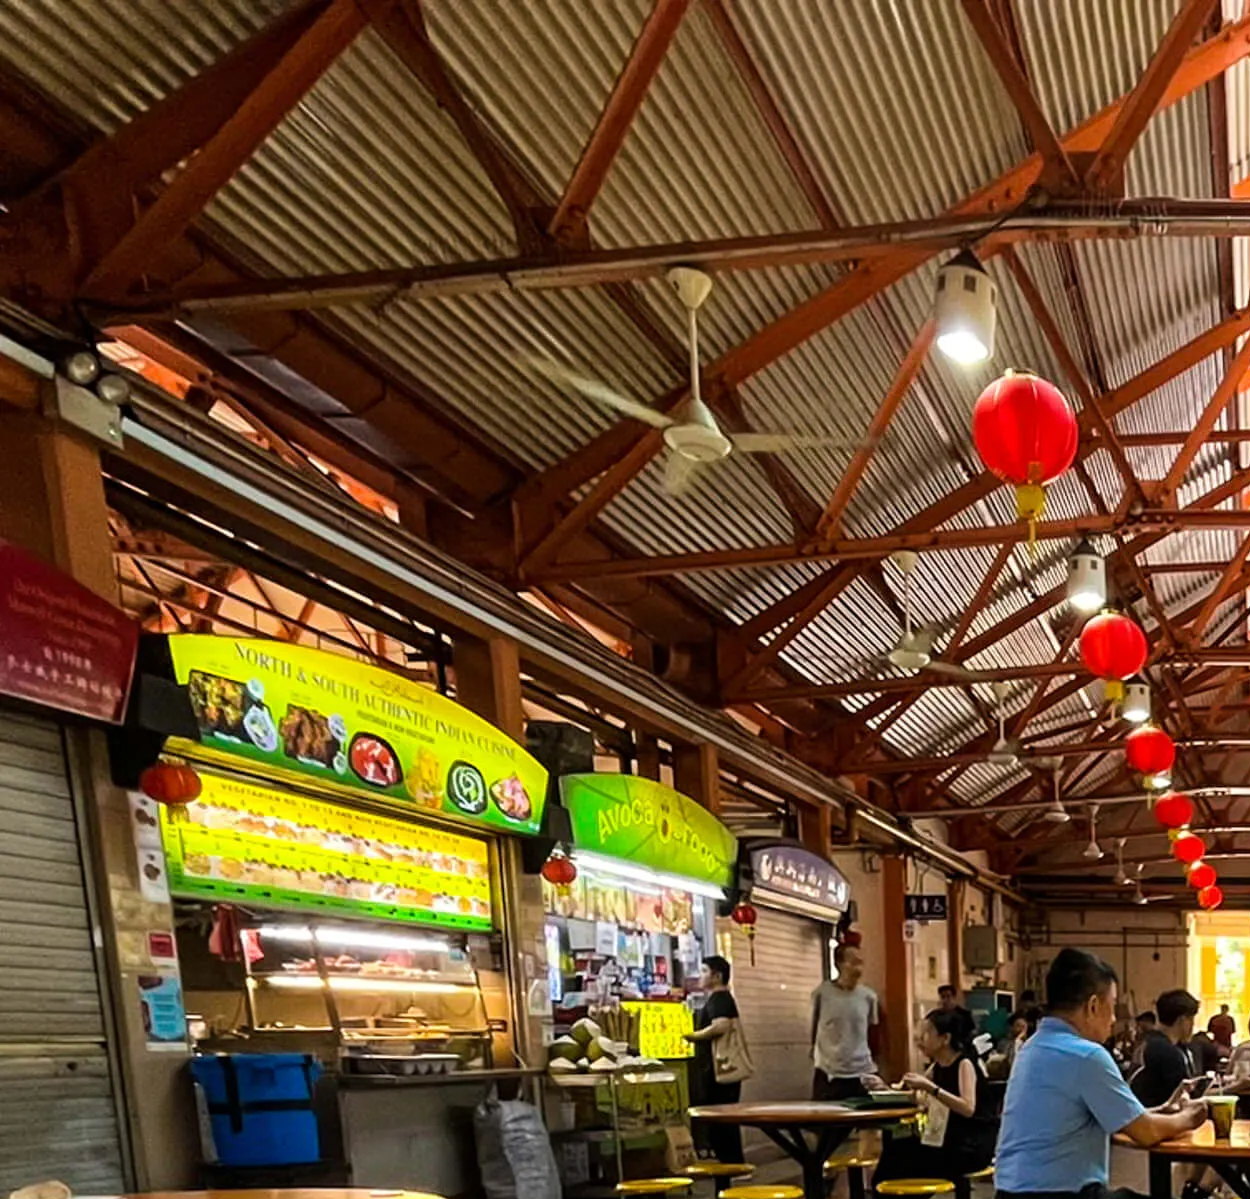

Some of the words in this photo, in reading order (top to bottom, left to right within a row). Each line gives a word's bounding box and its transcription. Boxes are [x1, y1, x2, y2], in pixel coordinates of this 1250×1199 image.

[234, 642, 292, 679] NORTH
[296, 668, 308, 685] &
[311, 672, 359, 702] SOUTH
[366, 694, 433, 729] AUTHENTIC
[435, 718, 476, 745] INDIAN
